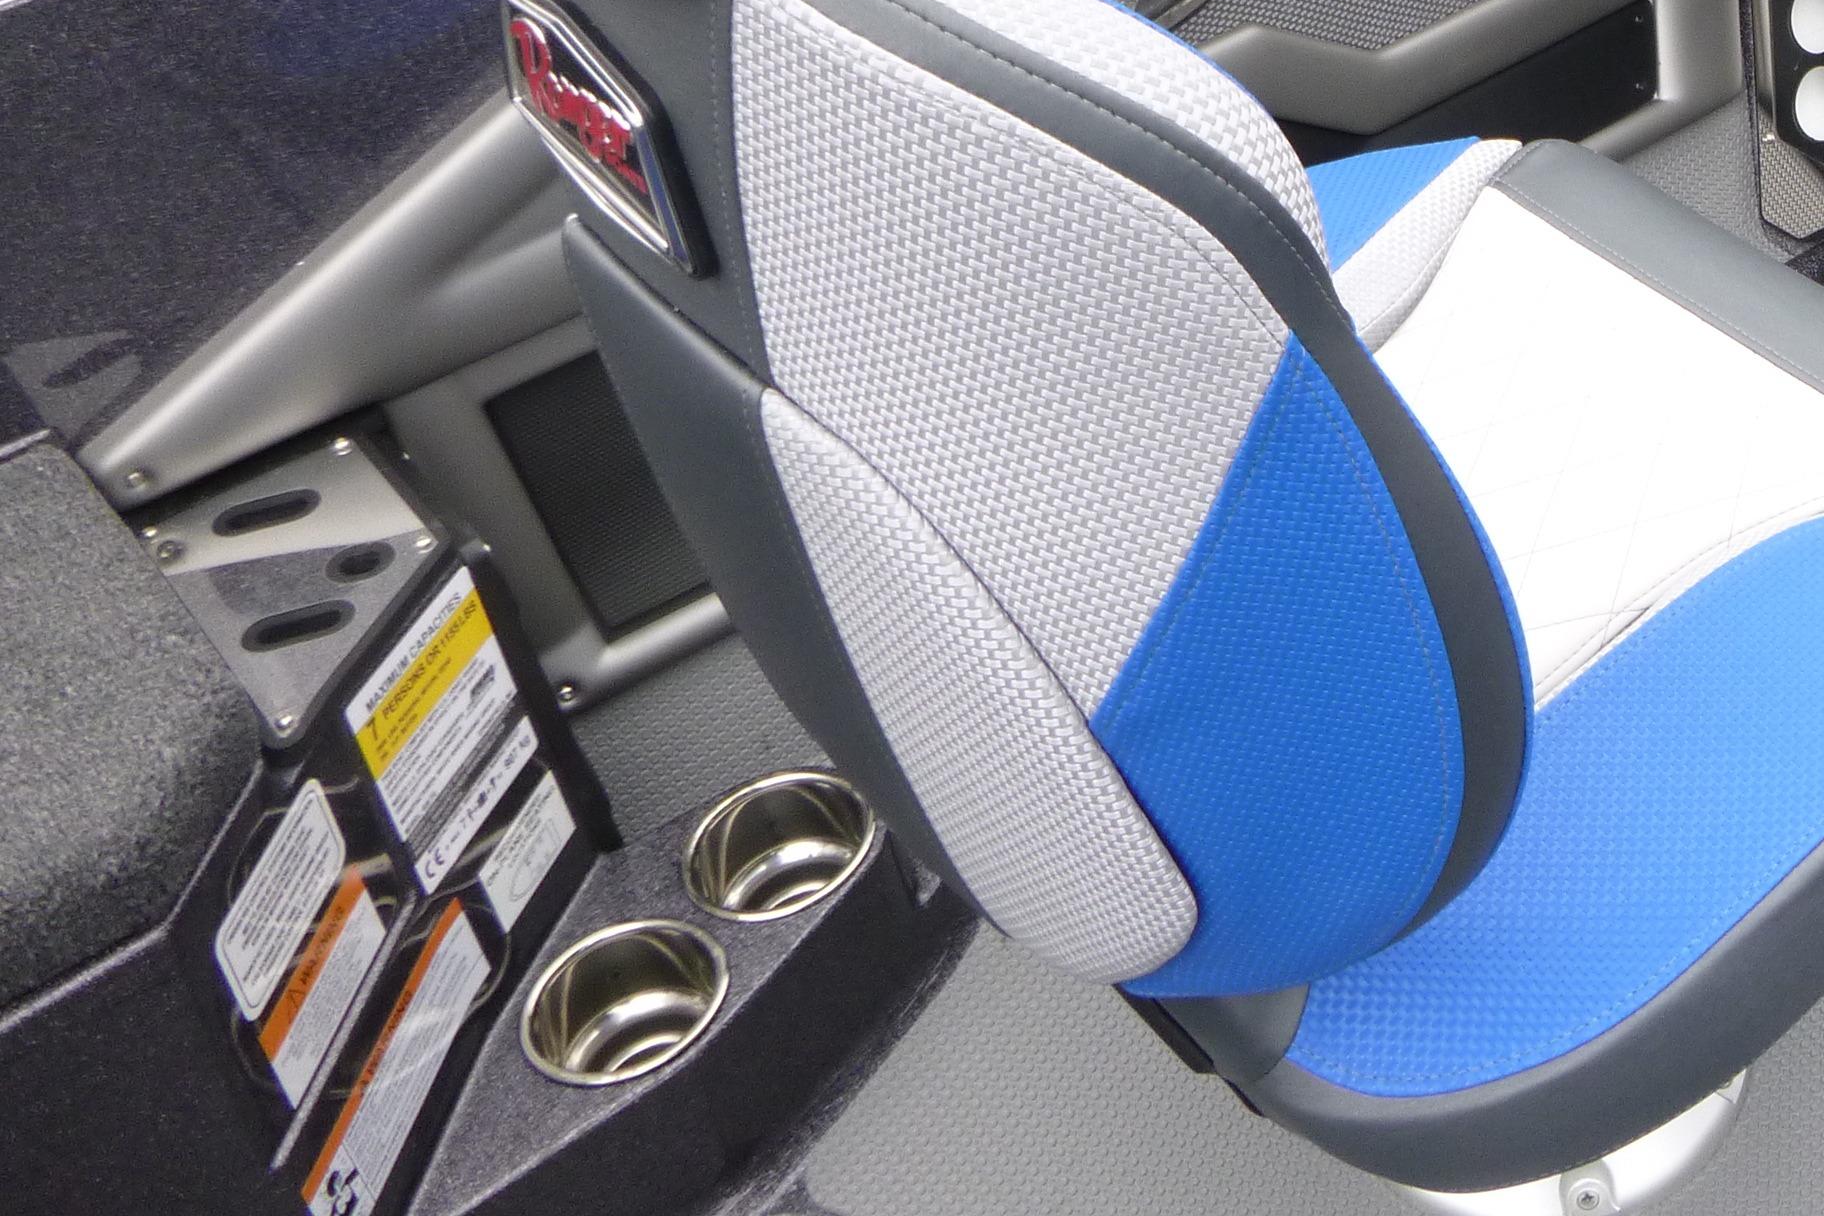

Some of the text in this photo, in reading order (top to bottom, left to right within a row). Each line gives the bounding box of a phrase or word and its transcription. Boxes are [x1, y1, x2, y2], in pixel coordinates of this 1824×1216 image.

[365, 654, 410, 713] MAXIMUM
[408, 591, 462, 660] CAPACITIES
[366, 716, 379, 741] 7
[381, 662, 425, 721] PERSONS
